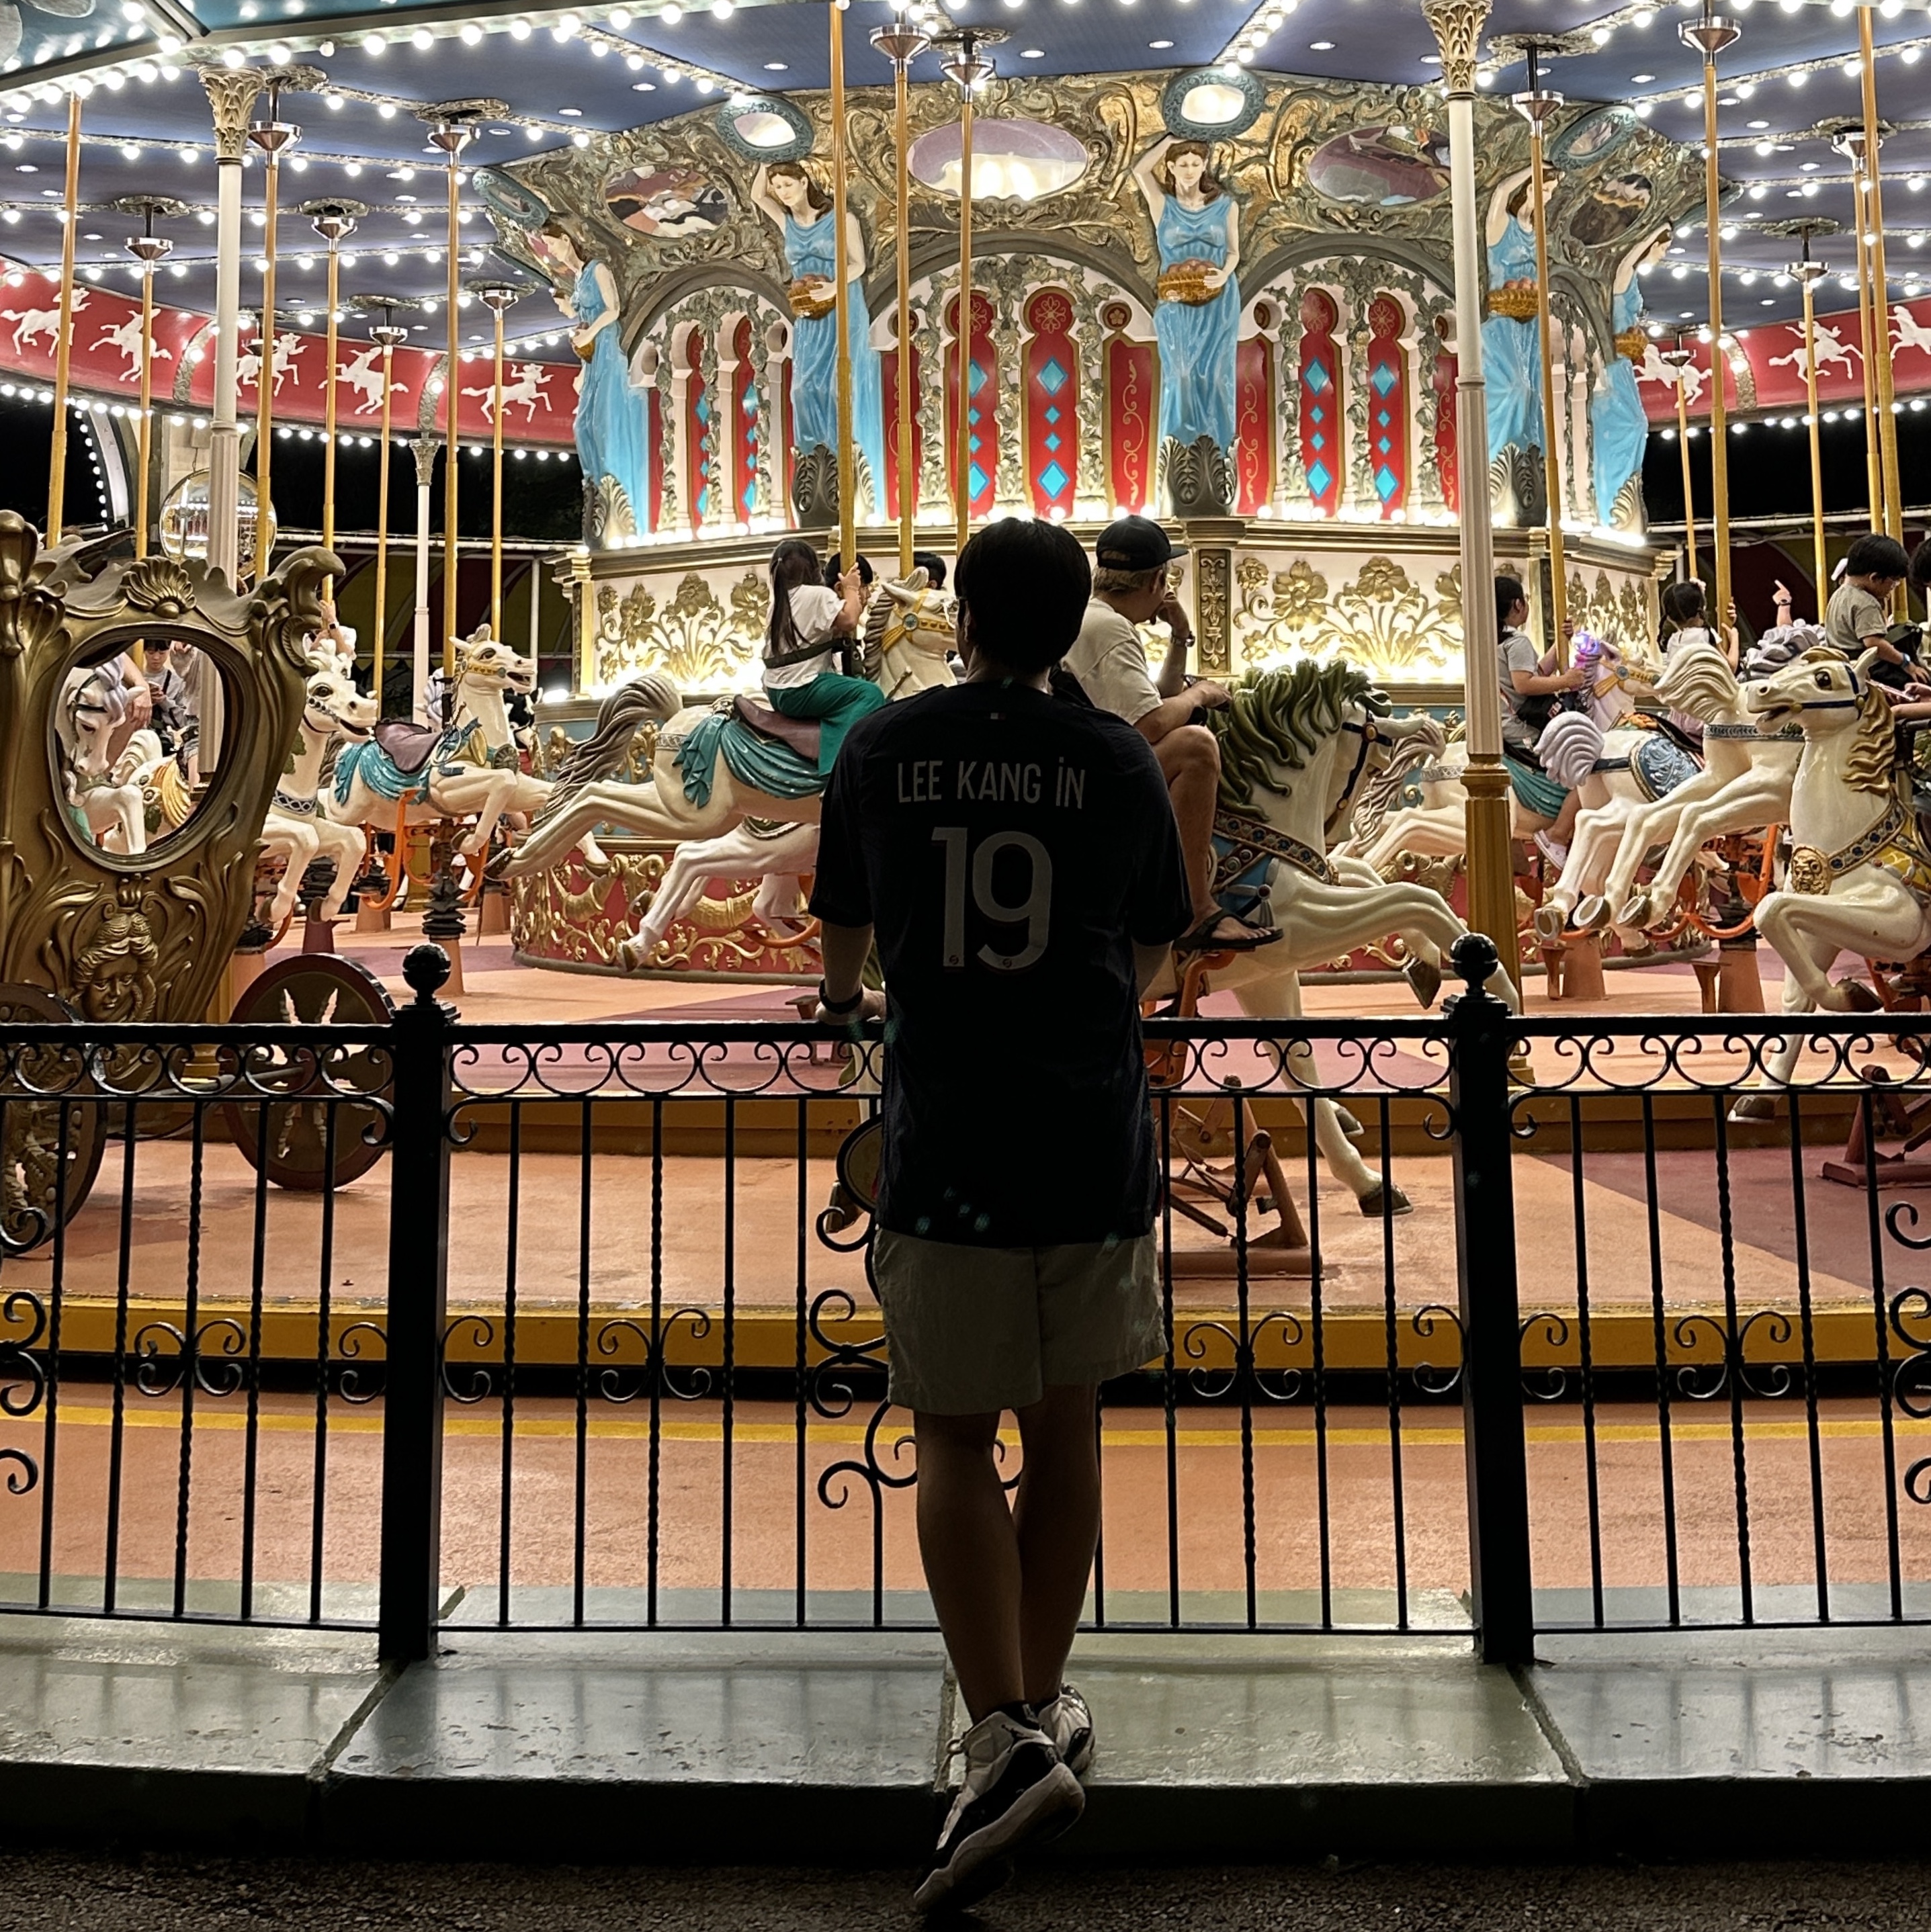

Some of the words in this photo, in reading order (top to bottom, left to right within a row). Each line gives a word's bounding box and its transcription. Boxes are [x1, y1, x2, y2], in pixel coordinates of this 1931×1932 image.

[897, 760, 943, 803] LEE
[956, 760, 1041, 804] KANG
[931, 826, 1053, 971] 19
